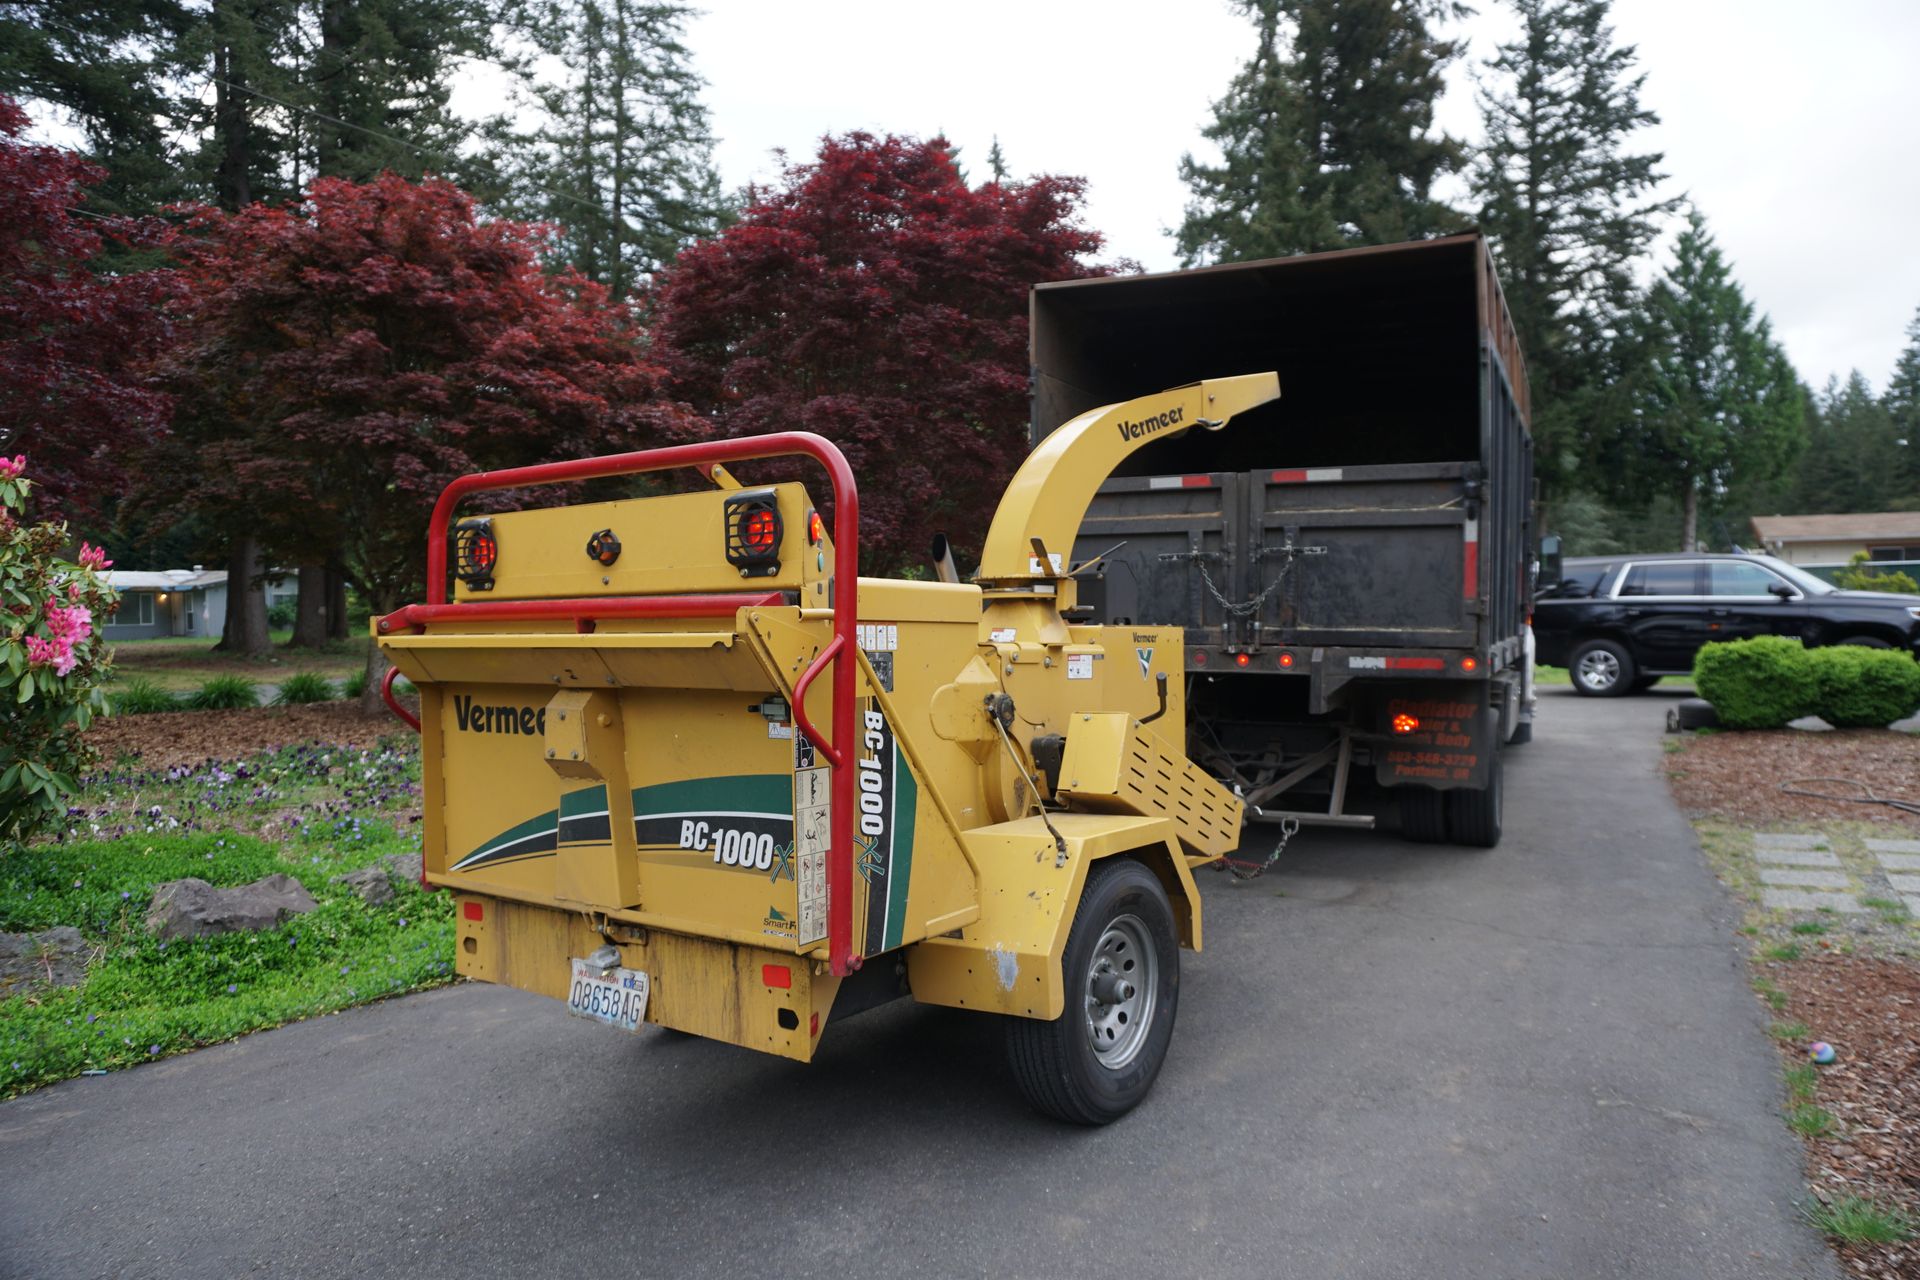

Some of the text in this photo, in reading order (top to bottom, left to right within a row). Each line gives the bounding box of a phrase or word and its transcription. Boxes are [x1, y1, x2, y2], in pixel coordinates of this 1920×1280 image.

[1117, 406, 1184, 442] Vermeer
[1132, 631, 1158, 644] Vermeer
[453, 694, 545, 736] Vermee
[763, 917, 797, 931] SmartF
